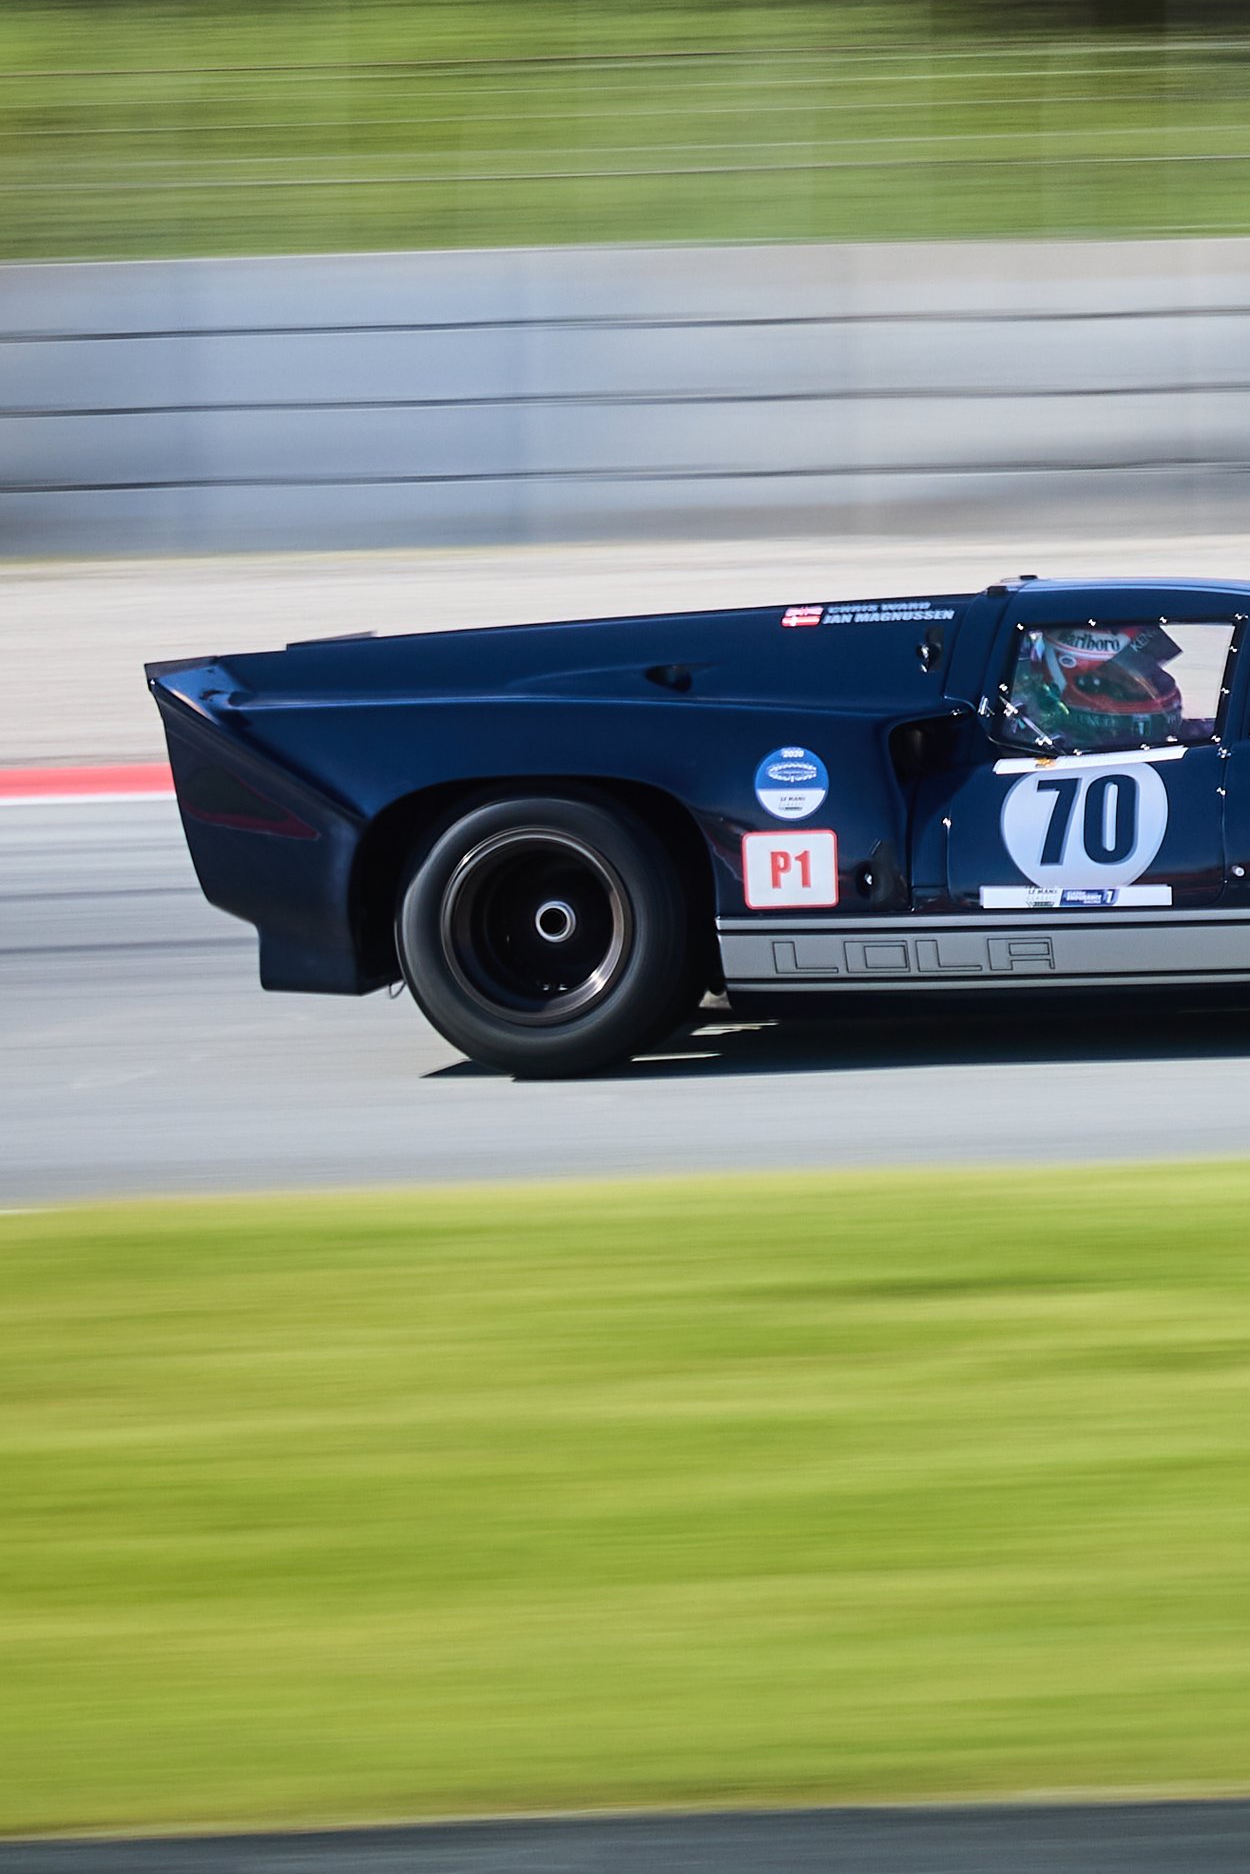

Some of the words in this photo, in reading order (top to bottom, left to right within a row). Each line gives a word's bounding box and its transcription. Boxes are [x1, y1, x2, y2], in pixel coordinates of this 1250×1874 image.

[822, 613, 853, 625] JAN
[854, 610, 955, 623] MAGNUSSEN
[881, 601, 932, 611] WARD
[1036, 773, 1141, 867] 70
[770, 849, 812, 889] P1
[772, 936, 1055, 974] LOLA
